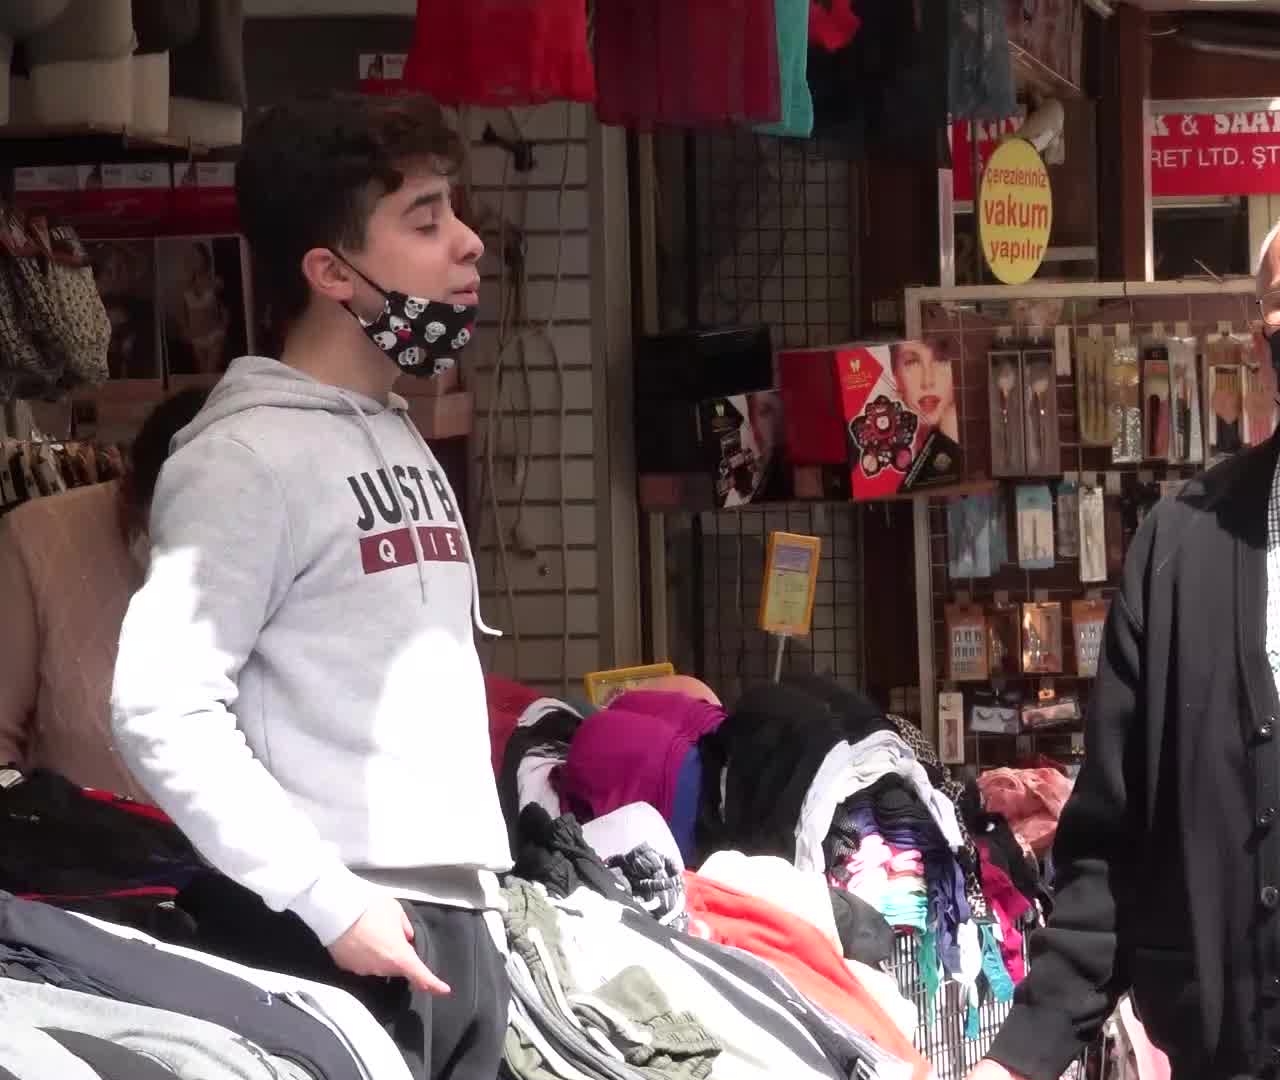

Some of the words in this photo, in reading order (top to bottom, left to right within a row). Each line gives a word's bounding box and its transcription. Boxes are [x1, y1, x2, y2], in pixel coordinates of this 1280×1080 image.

[1181, 114, 1199, 135] &
[1199, 147, 1245, 167] LTD.
[984, 194, 1048, 229] vakum
[990, 238, 1044, 262] yapılır
[347, 465, 434, 531] JUST
[378, 532, 466, 563] QIE
